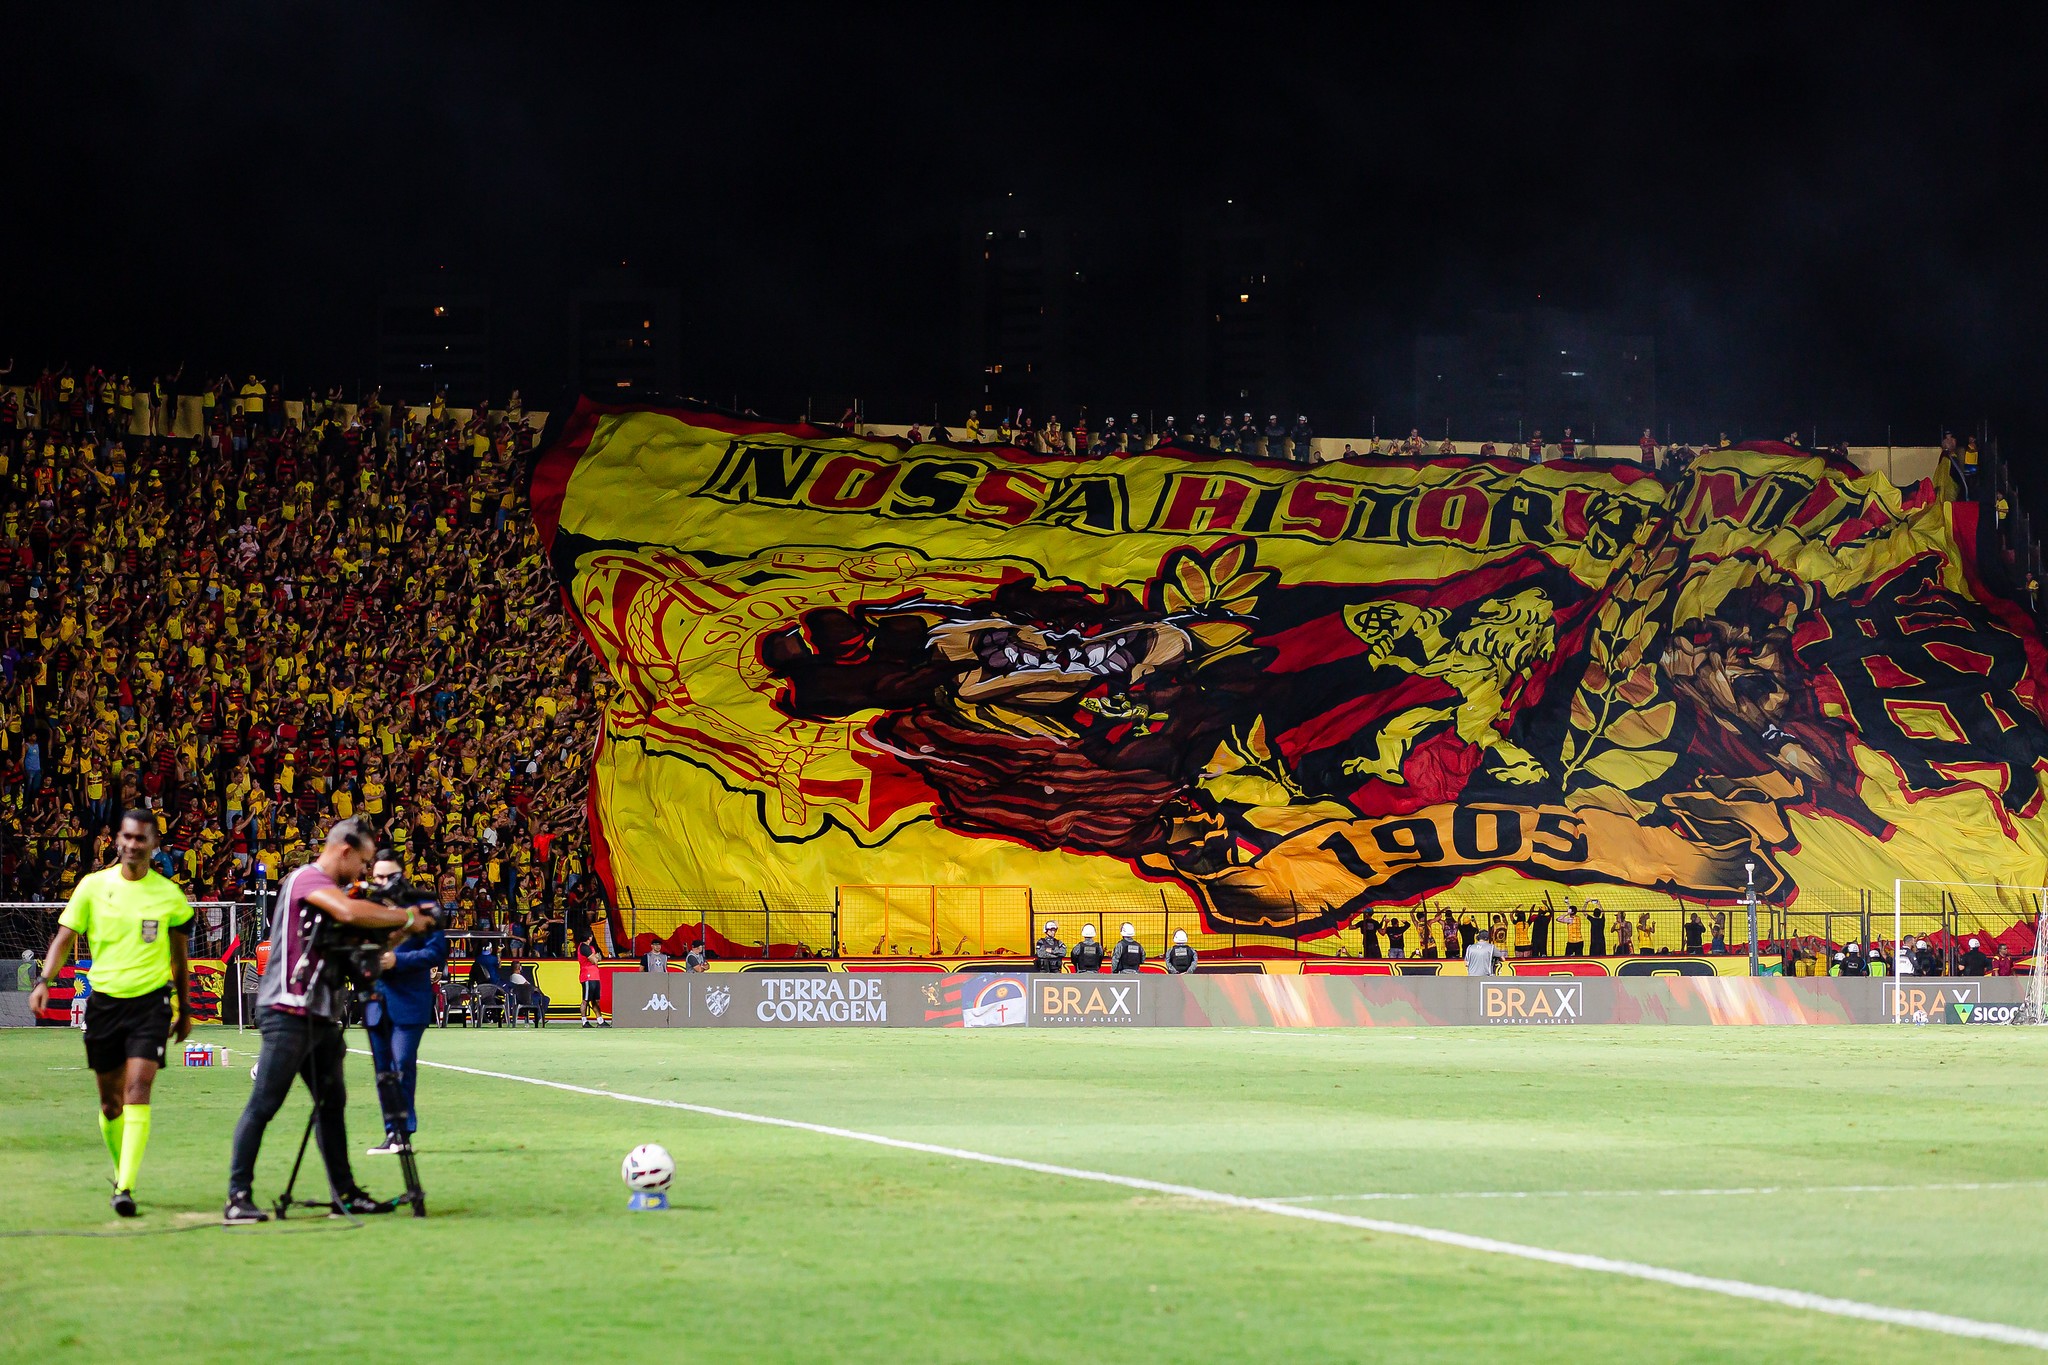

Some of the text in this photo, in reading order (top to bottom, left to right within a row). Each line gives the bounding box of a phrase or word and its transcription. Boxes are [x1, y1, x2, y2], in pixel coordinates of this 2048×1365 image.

[706, 444, 1120, 534] NOSSA
[703, 587, 848, 646] SPORT
[1317, 805, 1590, 879] 1905
[761, 978, 882, 1000] TERRA DE
[1043, 986, 1131, 1015] BRAX
[1486, 988, 1577, 1018] BRAX
[756, 1001, 887, 1022] CORAGEM
